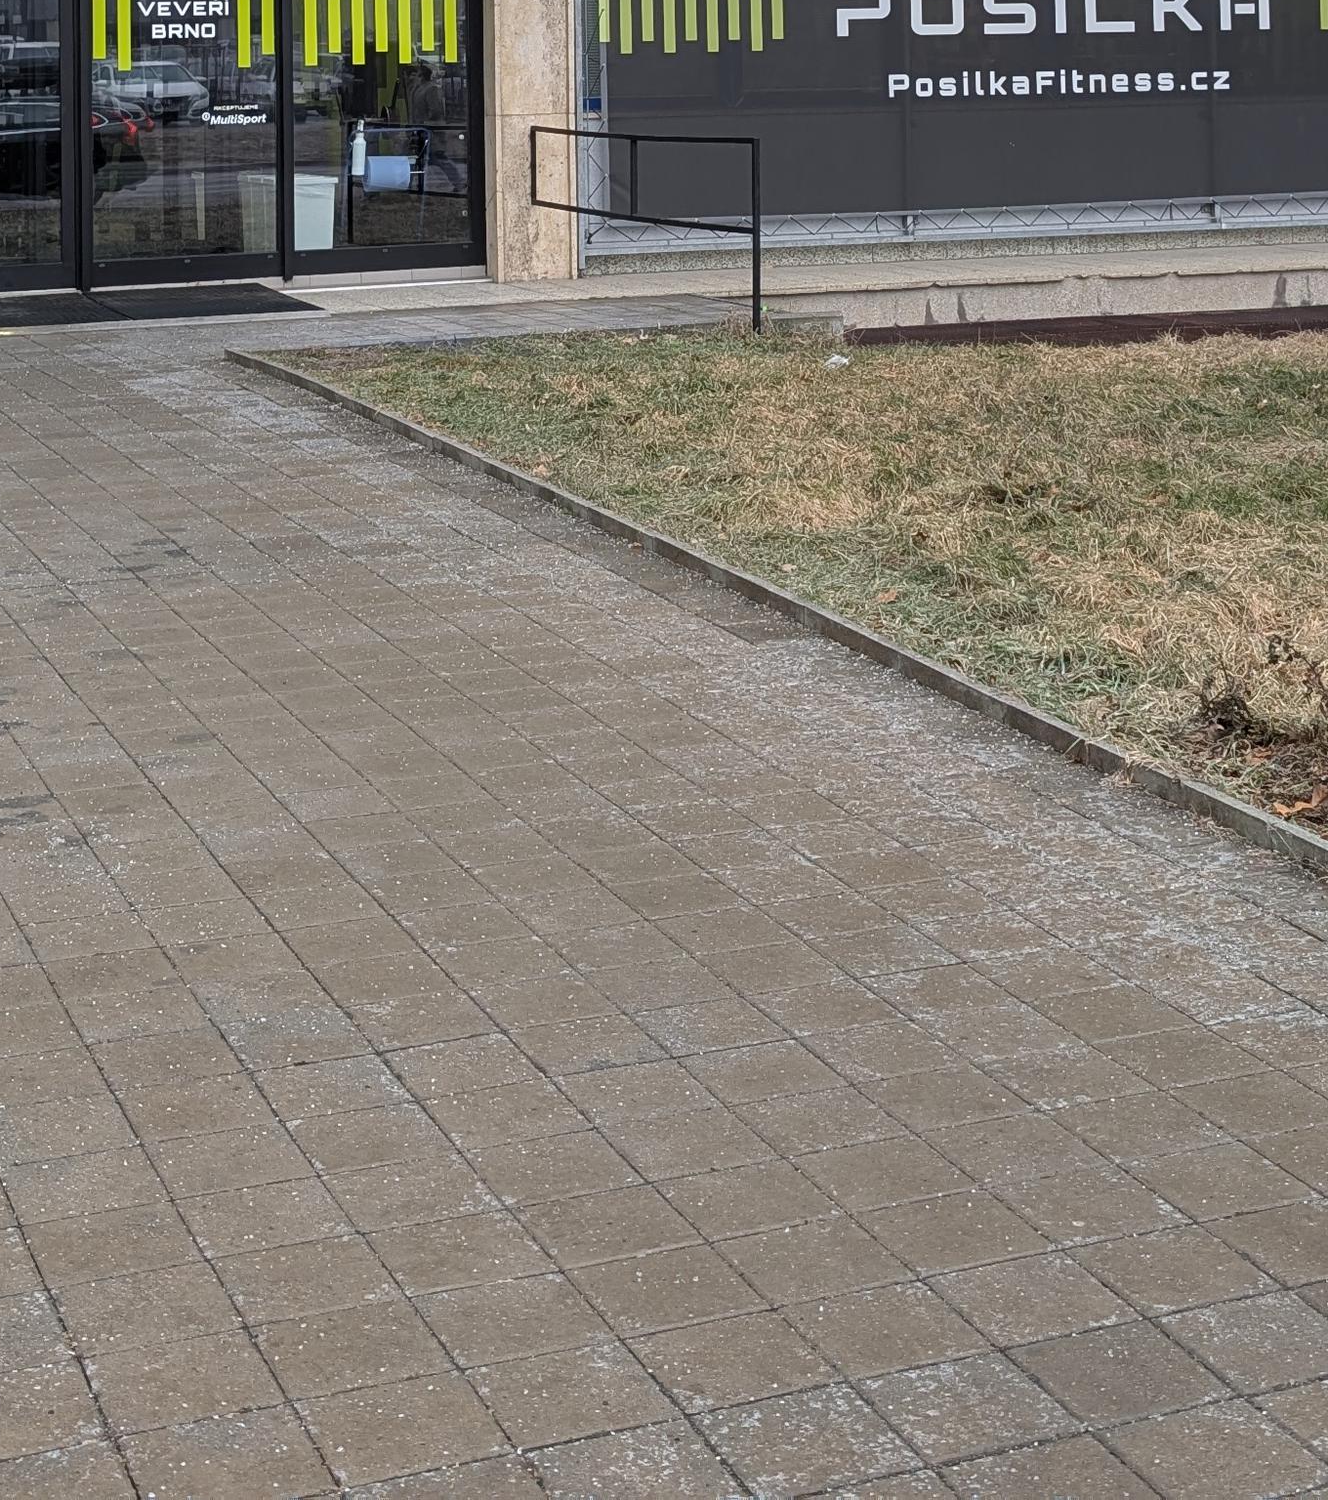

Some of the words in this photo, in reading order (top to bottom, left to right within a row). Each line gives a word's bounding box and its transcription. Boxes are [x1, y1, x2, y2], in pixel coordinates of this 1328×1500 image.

[151, 23, 216, 39] BRNO
[888, 70, 1231, 98] PosilkaFitness.cz
[210, 113, 267, 125] MultiSport
